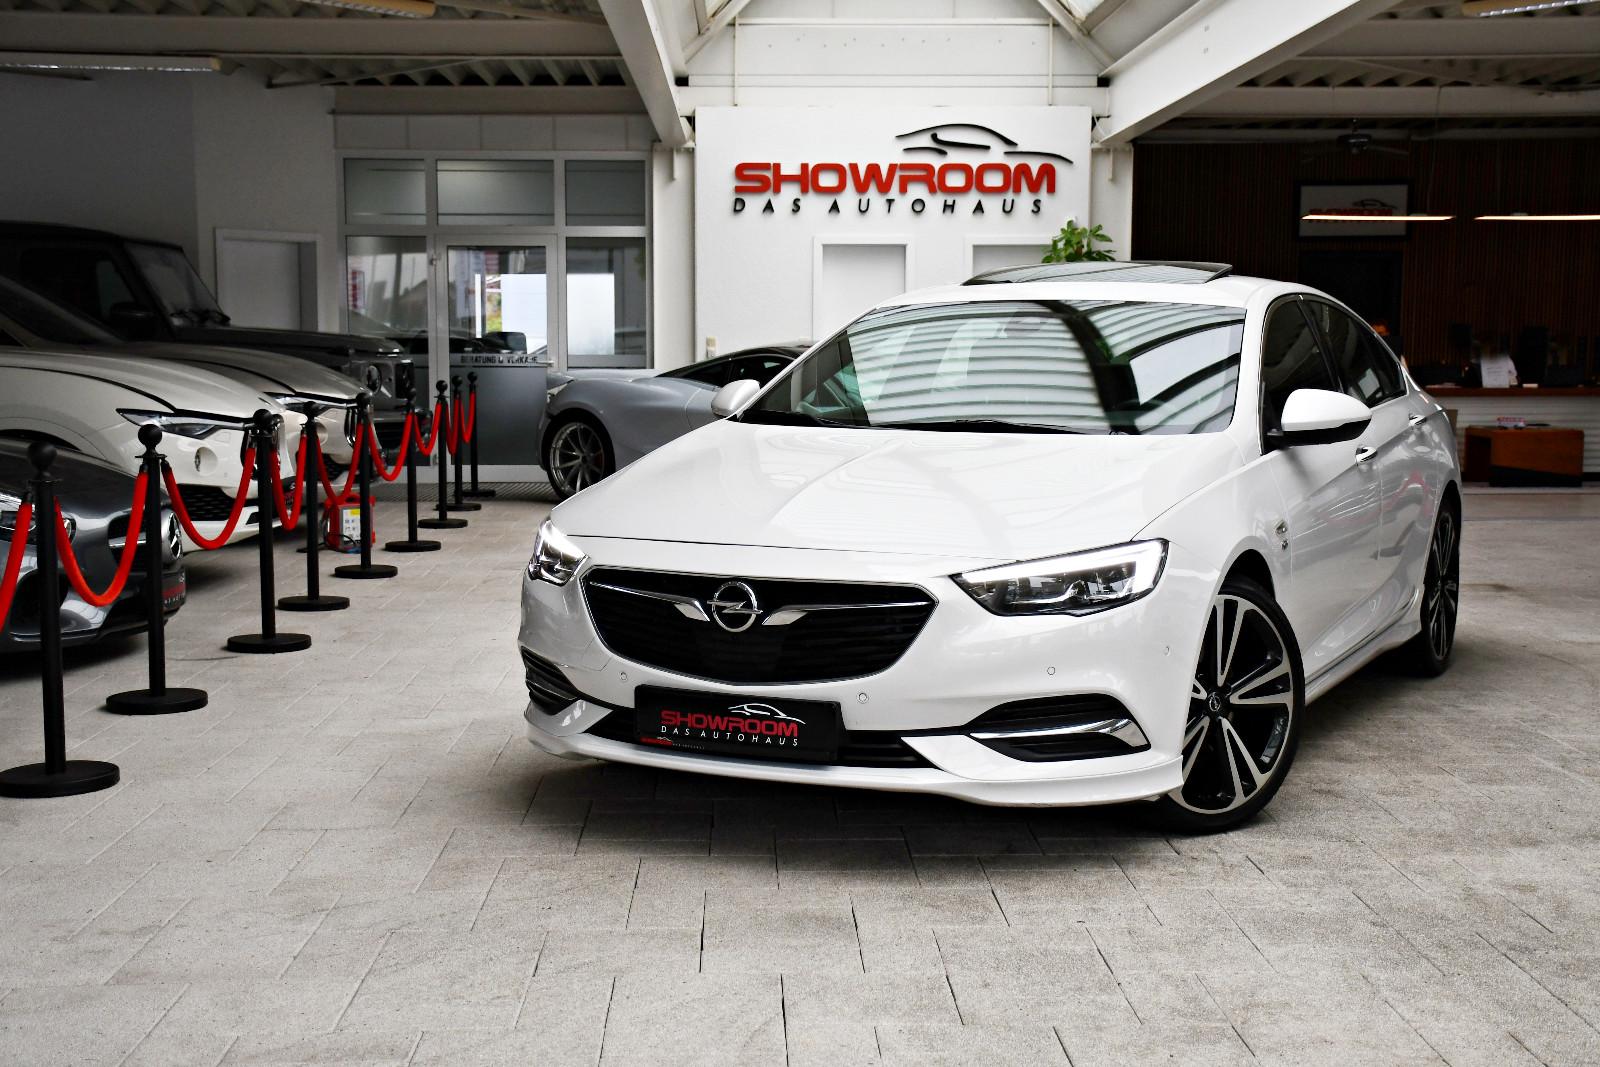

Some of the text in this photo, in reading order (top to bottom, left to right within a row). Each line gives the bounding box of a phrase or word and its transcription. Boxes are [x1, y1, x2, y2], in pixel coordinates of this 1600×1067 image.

[734, 162, 1056, 194] SHOWROOM
[733, 198, 1042, 214] DAS AUTOHAUS
[660, 709, 798, 737] SHOWROOM
[661, 725, 690, 736] DAS
[700, 729, 798, 746] AUTOHAUS
